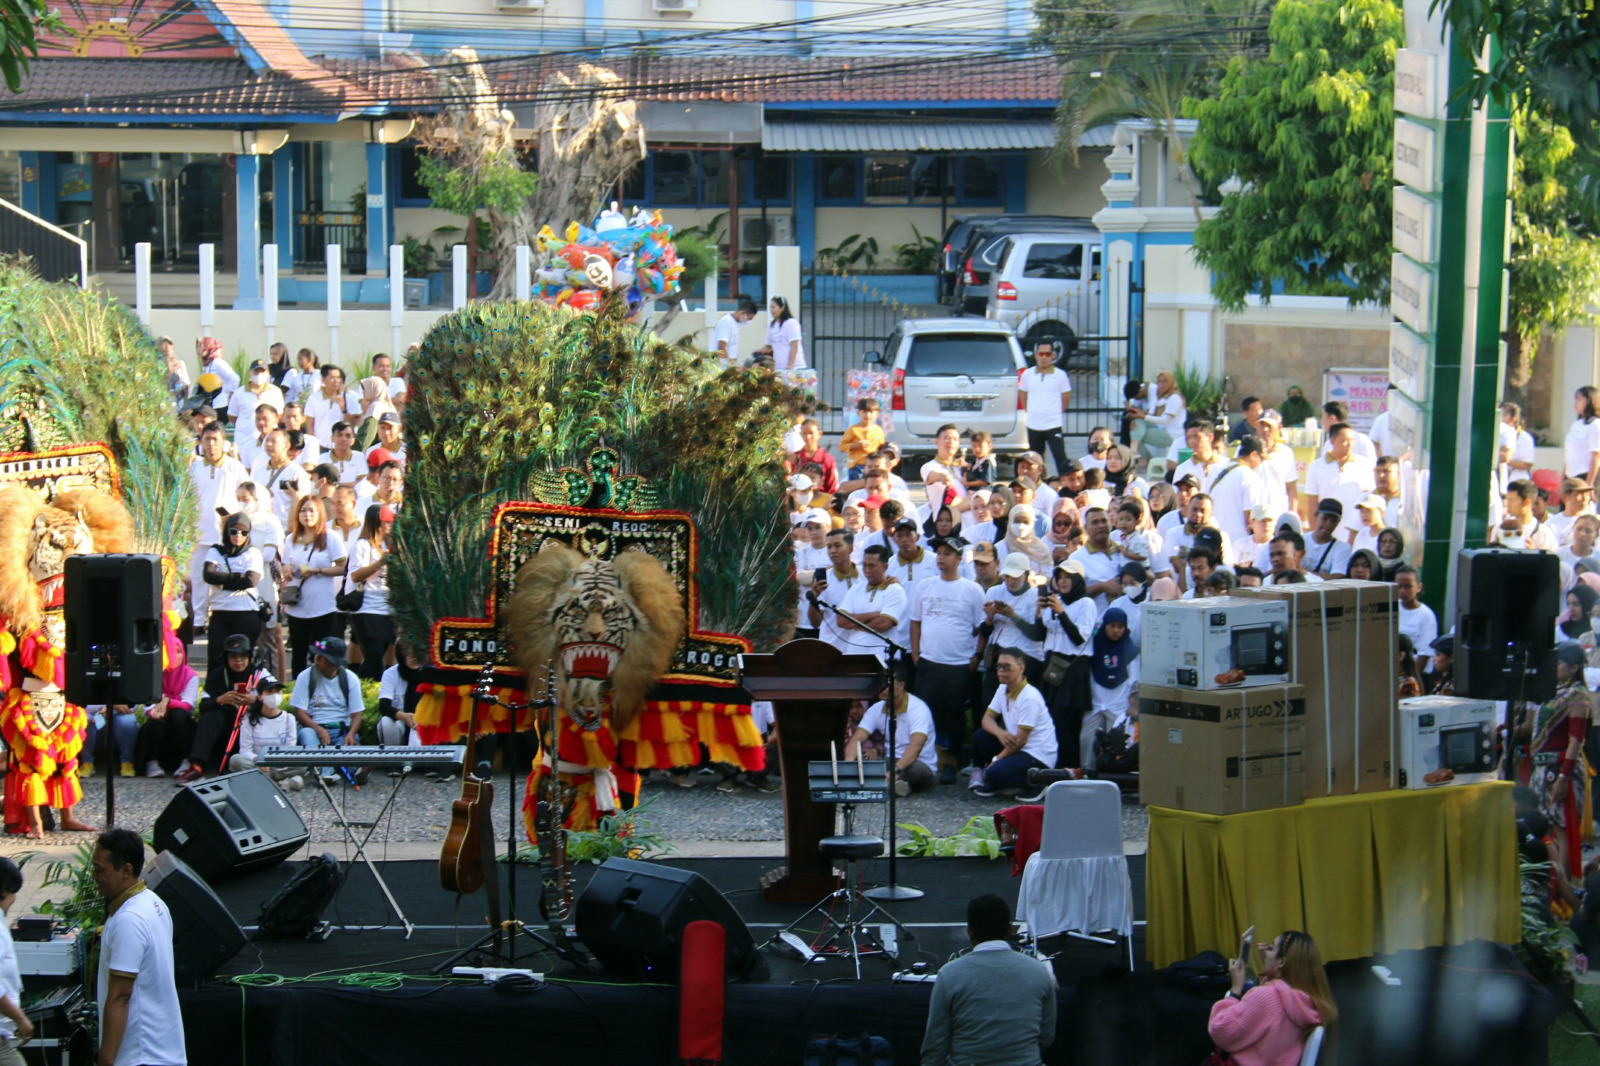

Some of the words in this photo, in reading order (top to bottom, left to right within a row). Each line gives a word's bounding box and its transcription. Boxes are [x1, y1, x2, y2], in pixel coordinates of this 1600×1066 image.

[543, 516, 581, 528] SENI
[611, 521, 649, 532] REOG
[444, 639, 496, 653] PONO
